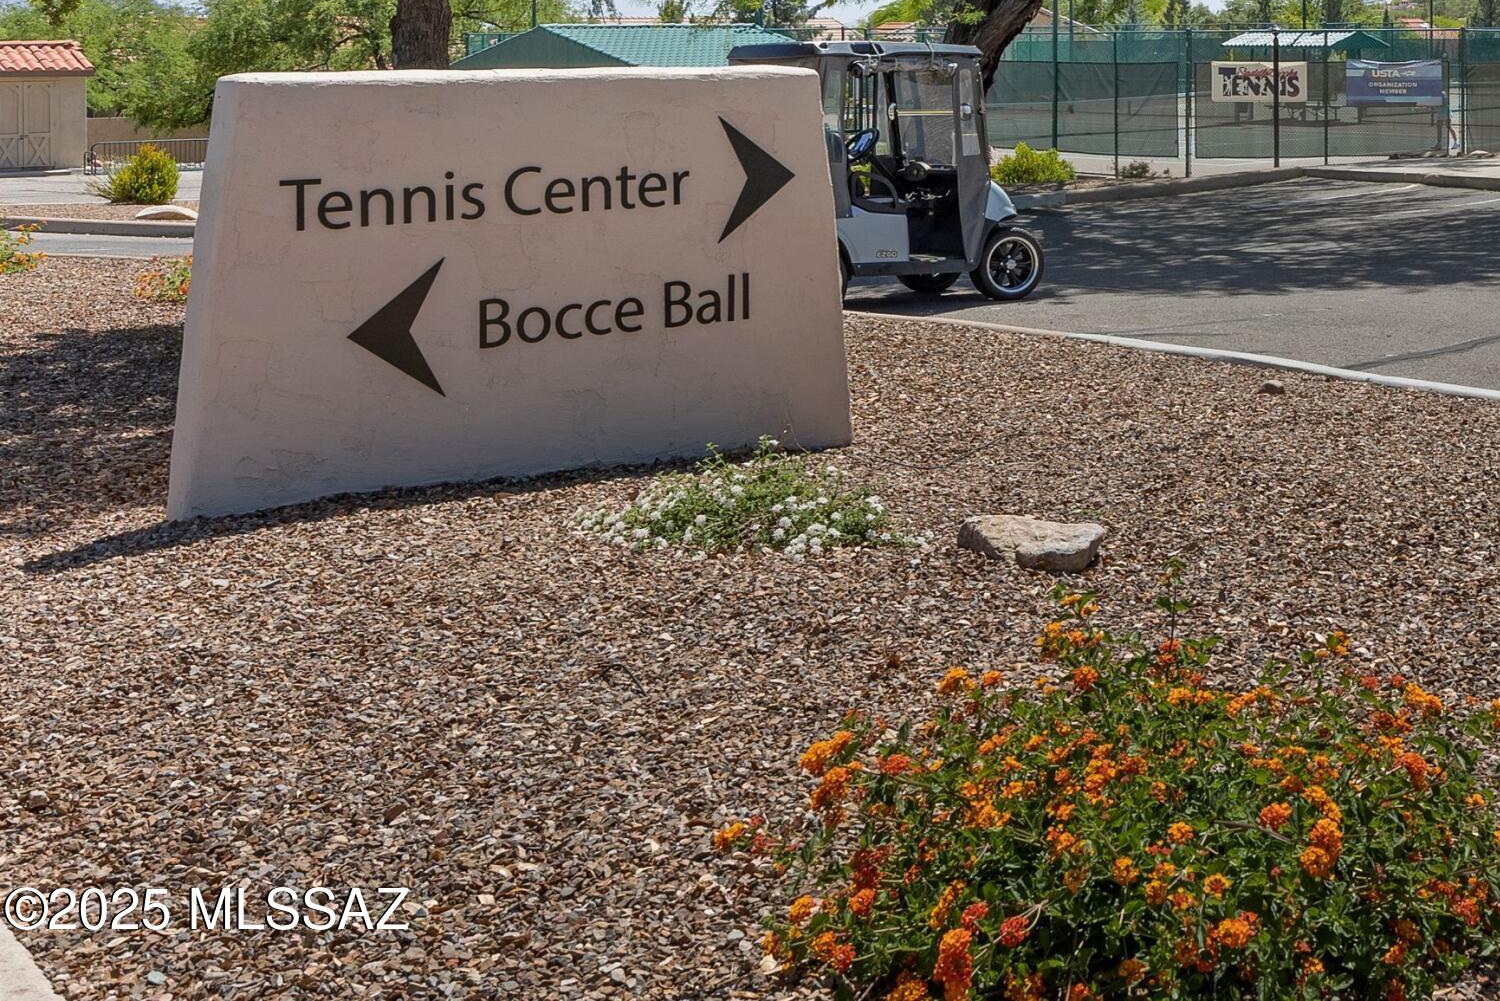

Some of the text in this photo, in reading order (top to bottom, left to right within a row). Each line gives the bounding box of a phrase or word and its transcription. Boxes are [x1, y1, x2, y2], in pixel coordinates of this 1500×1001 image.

[1371, 69, 1400, 78] USTA
[1379, 88, 1407, 96] MEMBER
[278, 165, 690, 232] Tennis Center
[478, 272, 750, 350] Bocce Ball
